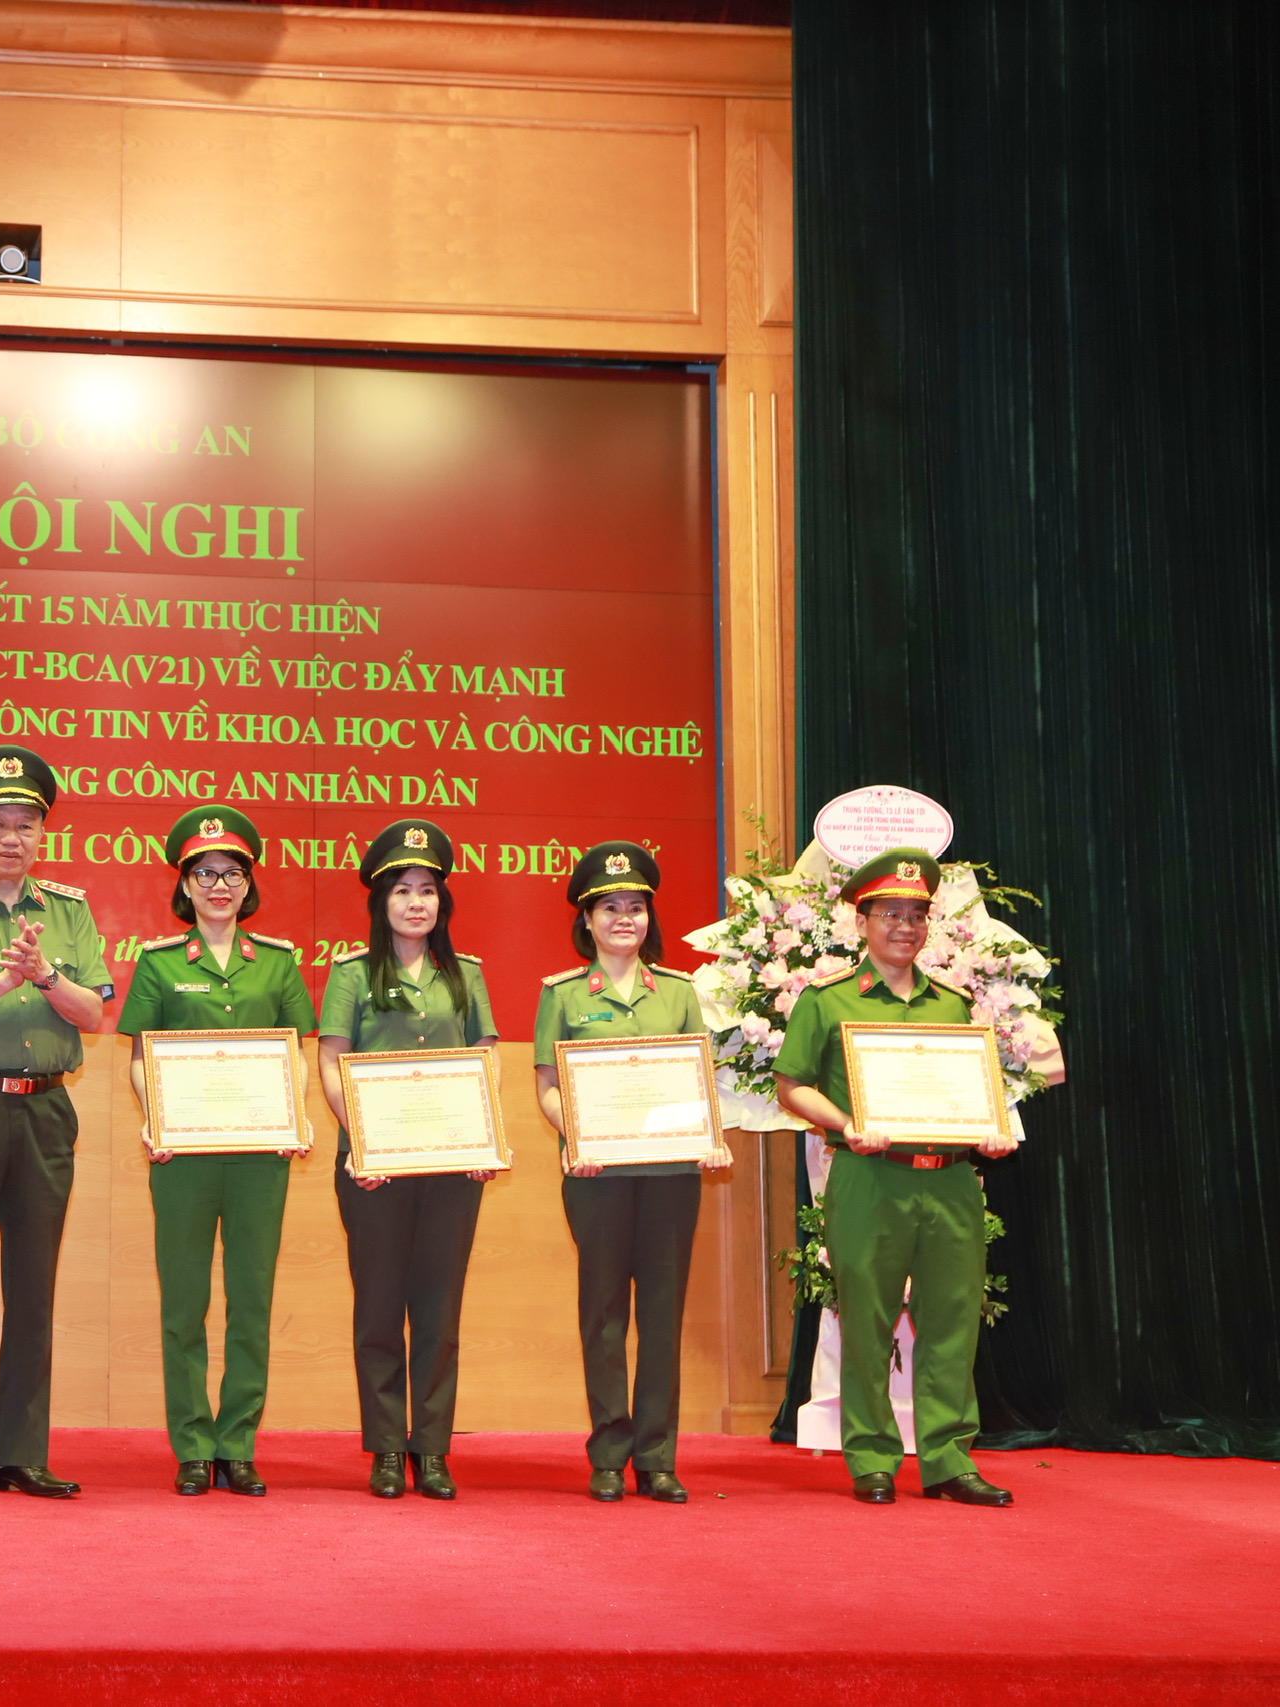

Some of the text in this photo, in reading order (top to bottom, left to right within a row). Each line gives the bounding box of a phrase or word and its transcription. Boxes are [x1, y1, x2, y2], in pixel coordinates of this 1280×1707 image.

[193, 424, 252, 457] AN
[104, 500, 305, 575] NGHỊ
[41, 596, 75, 624] 15
[82, 593, 170, 627] NĂM
[177, 600, 281, 636] THỰC
[290, 598, 381, 640] HIỆN
[211, 645, 261, 686] VỀ
[269, 653, 356, 696] VIỆC
[364, 649, 443, 691] ĐẨY
[451, 665, 565, 701] MẠNH
[85, 709, 150, 738] TIN
[158, 700, 208, 740] VỀ
[217, 713, 325, 744] KHOA
[335, 717, 415, 753] HỌC
[425, 713, 476, 749] VÀ
[485, 716, 592, 753] CÔNG
[600, 721, 702, 763] NGHỆ
[108, 761, 217, 798] CÔNG
[226, 772, 278, 799] AN
[286, 766, 392, 803] NHÂN
[401, 769, 478, 806] DÂN
[35, 825, 73, 862] HÍ
[85, 827, 169, 864] CÔN
[281, 832, 374, 870] NHÂ
